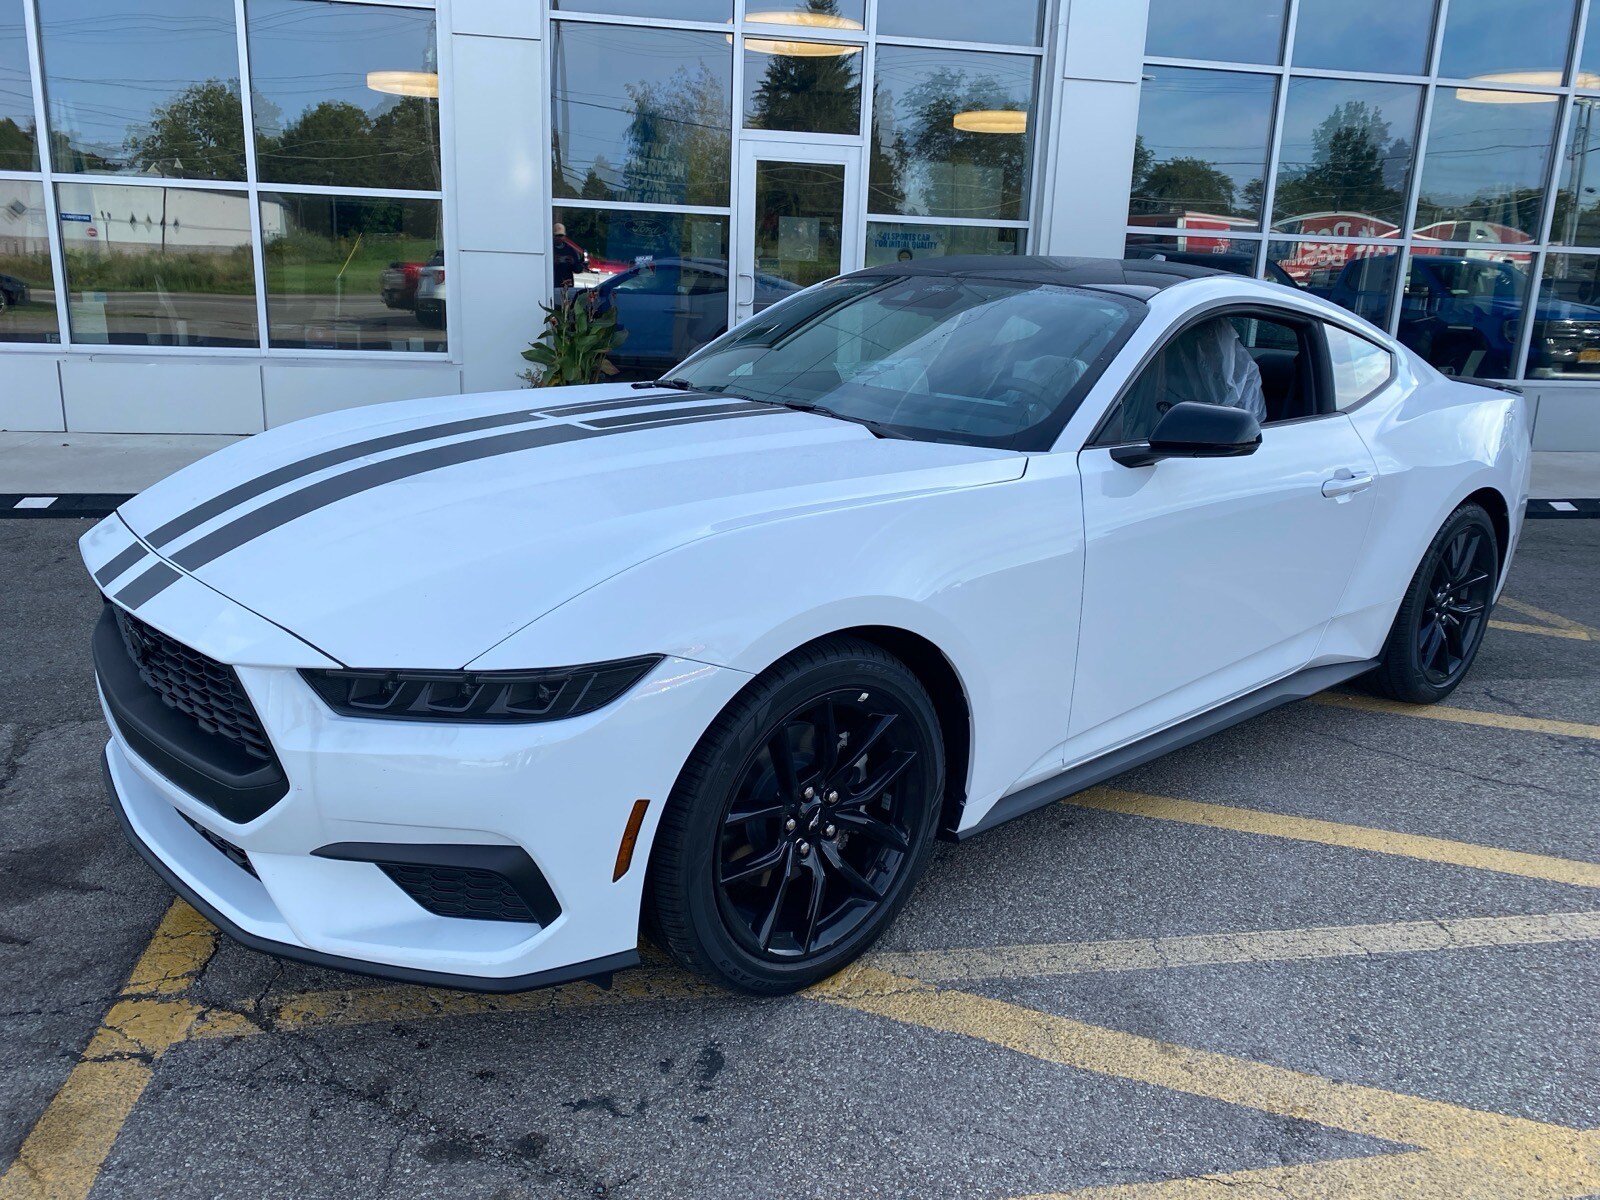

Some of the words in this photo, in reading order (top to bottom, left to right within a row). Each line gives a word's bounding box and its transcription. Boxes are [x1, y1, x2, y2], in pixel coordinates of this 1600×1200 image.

[891, 232, 917, 241] SPORTS
[917, 233, 931, 241] CAR
[875, 239, 888, 248] FOR
[888, 240, 910, 248] INITIAL
[911, 241, 938, 250] QUALITY
